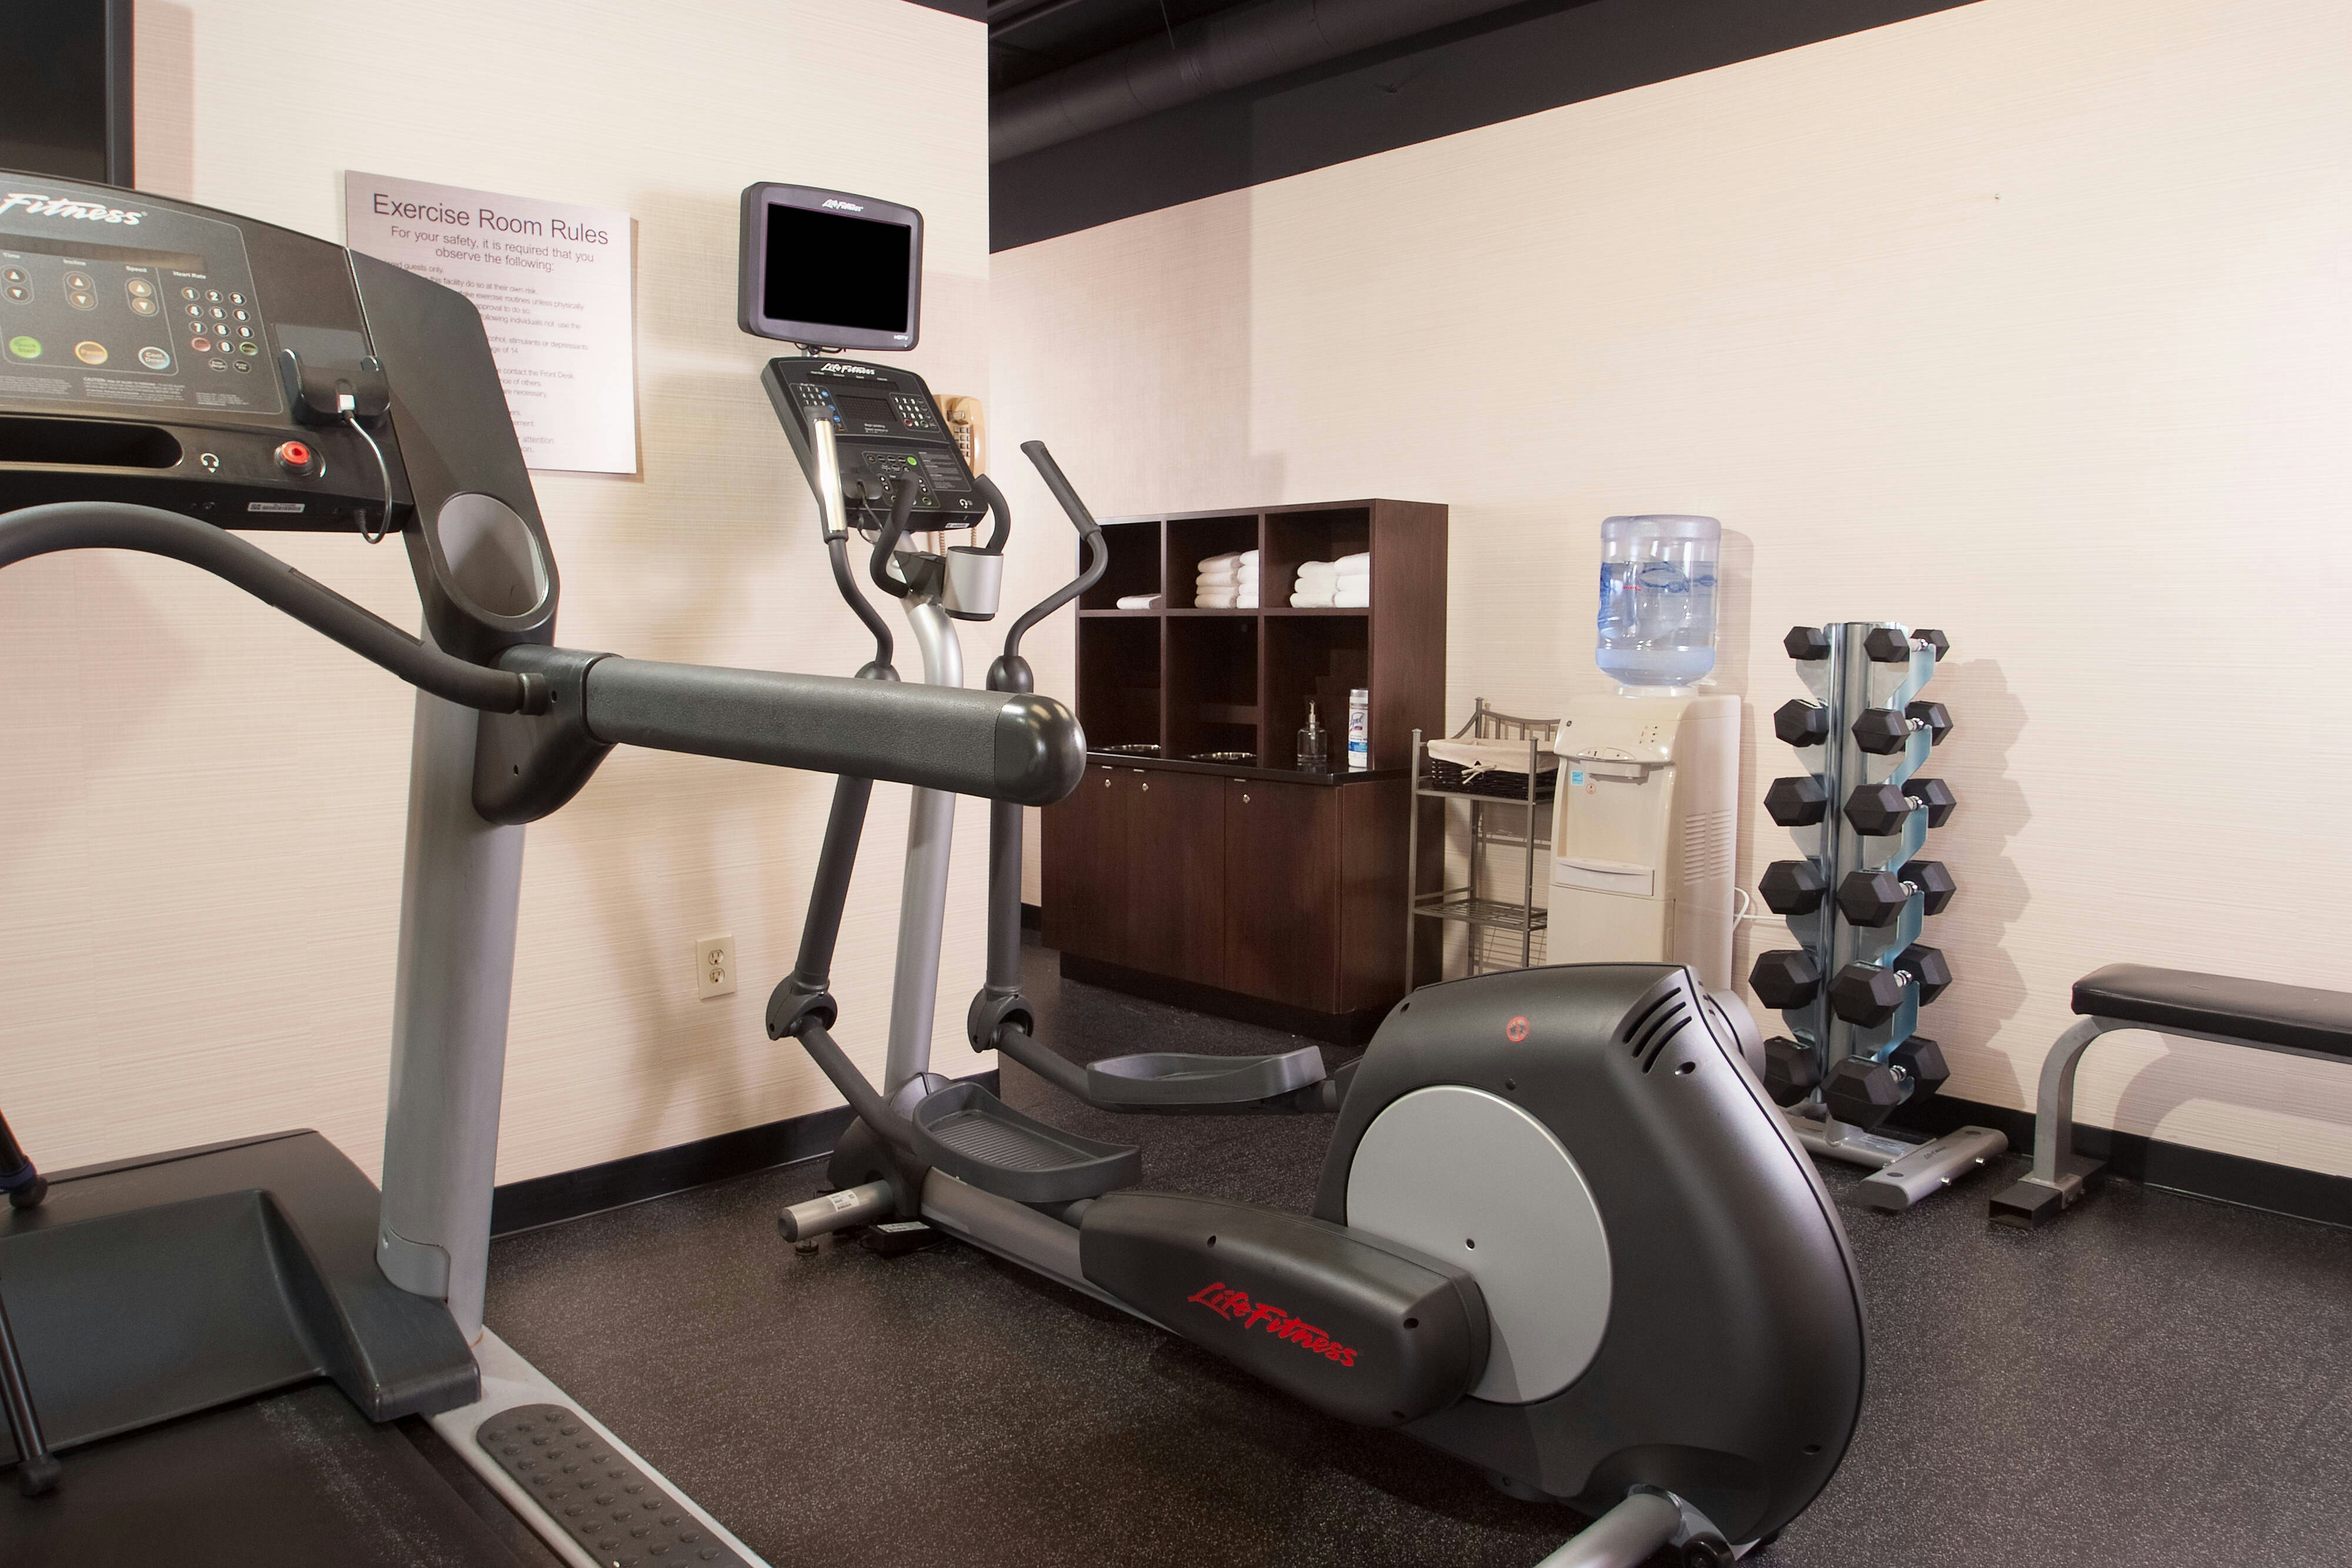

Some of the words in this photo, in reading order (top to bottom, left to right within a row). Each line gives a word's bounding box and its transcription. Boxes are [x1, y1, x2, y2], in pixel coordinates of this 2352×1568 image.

[0, 193, 142, 225] Fitness
[373, 193, 470, 226] Exercise
[479, 209, 542, 236] Room
[552, 219, 608, 245] Rules
[391, 226, 410, 238] For
[414, 231, 439, 243] your
[483, 238, 489, 249] it
[492, 240, 502, 250] is
[505, 242, 549, 256] required
[552, 248, 572, 260] that
[575, 252, 594, 263] you
[436, 246, 481, 262] observe
[485, 253, 502, 265] the
[506, 255, 554, 273] following:
[443, 278, 465, 287] facility
[186, 289, 195, 299] 1
[209, 291, 219, 302] 2
[232, 293, 243, 304] 3
[554, 300, 584, 310] physically
[189, 306, 200, 316] 4
[482, 314, 509, 324] ollowing
[510, 316, 543, 325] individuals
[193, 322, 202, 333] 7
[509, 337, 540, 346] stimulants
[550, 340, 589, 350] depressants
[503, 367, 527, 376] contact
[540, 369, 556, 377] Front
[821, 362, 842, 372] Life
[840, 365, 876, 375] Fitness
[523, 436, 554, 444] attention
[1187, 1282, 1252, 1321] Life
[1244, 1302, 1358, 1367] Fitness
